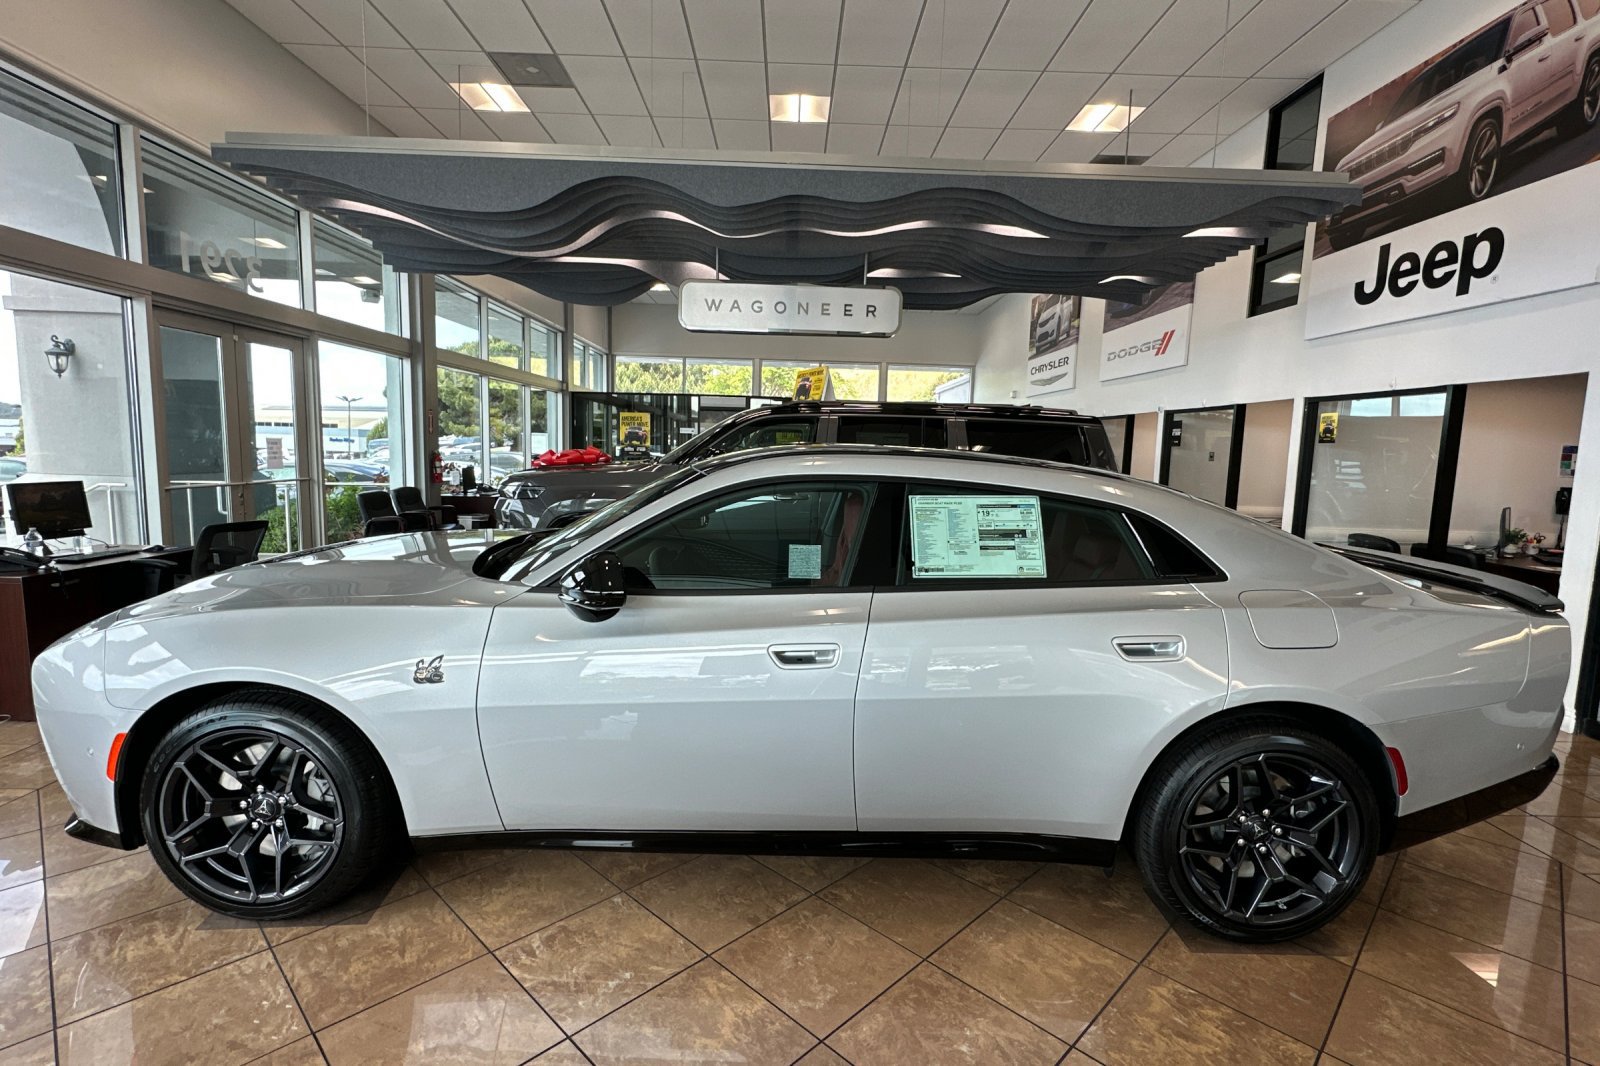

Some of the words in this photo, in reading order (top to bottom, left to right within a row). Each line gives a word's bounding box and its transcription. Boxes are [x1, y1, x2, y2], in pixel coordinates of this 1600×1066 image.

[1354, 226, 1504, 306] Jeep
[705, 298, 877, 317] WAGONEER
[1106, 338, 1163, 362] DODGE
[1030, 356, 1069, 376] CHRYSLER
